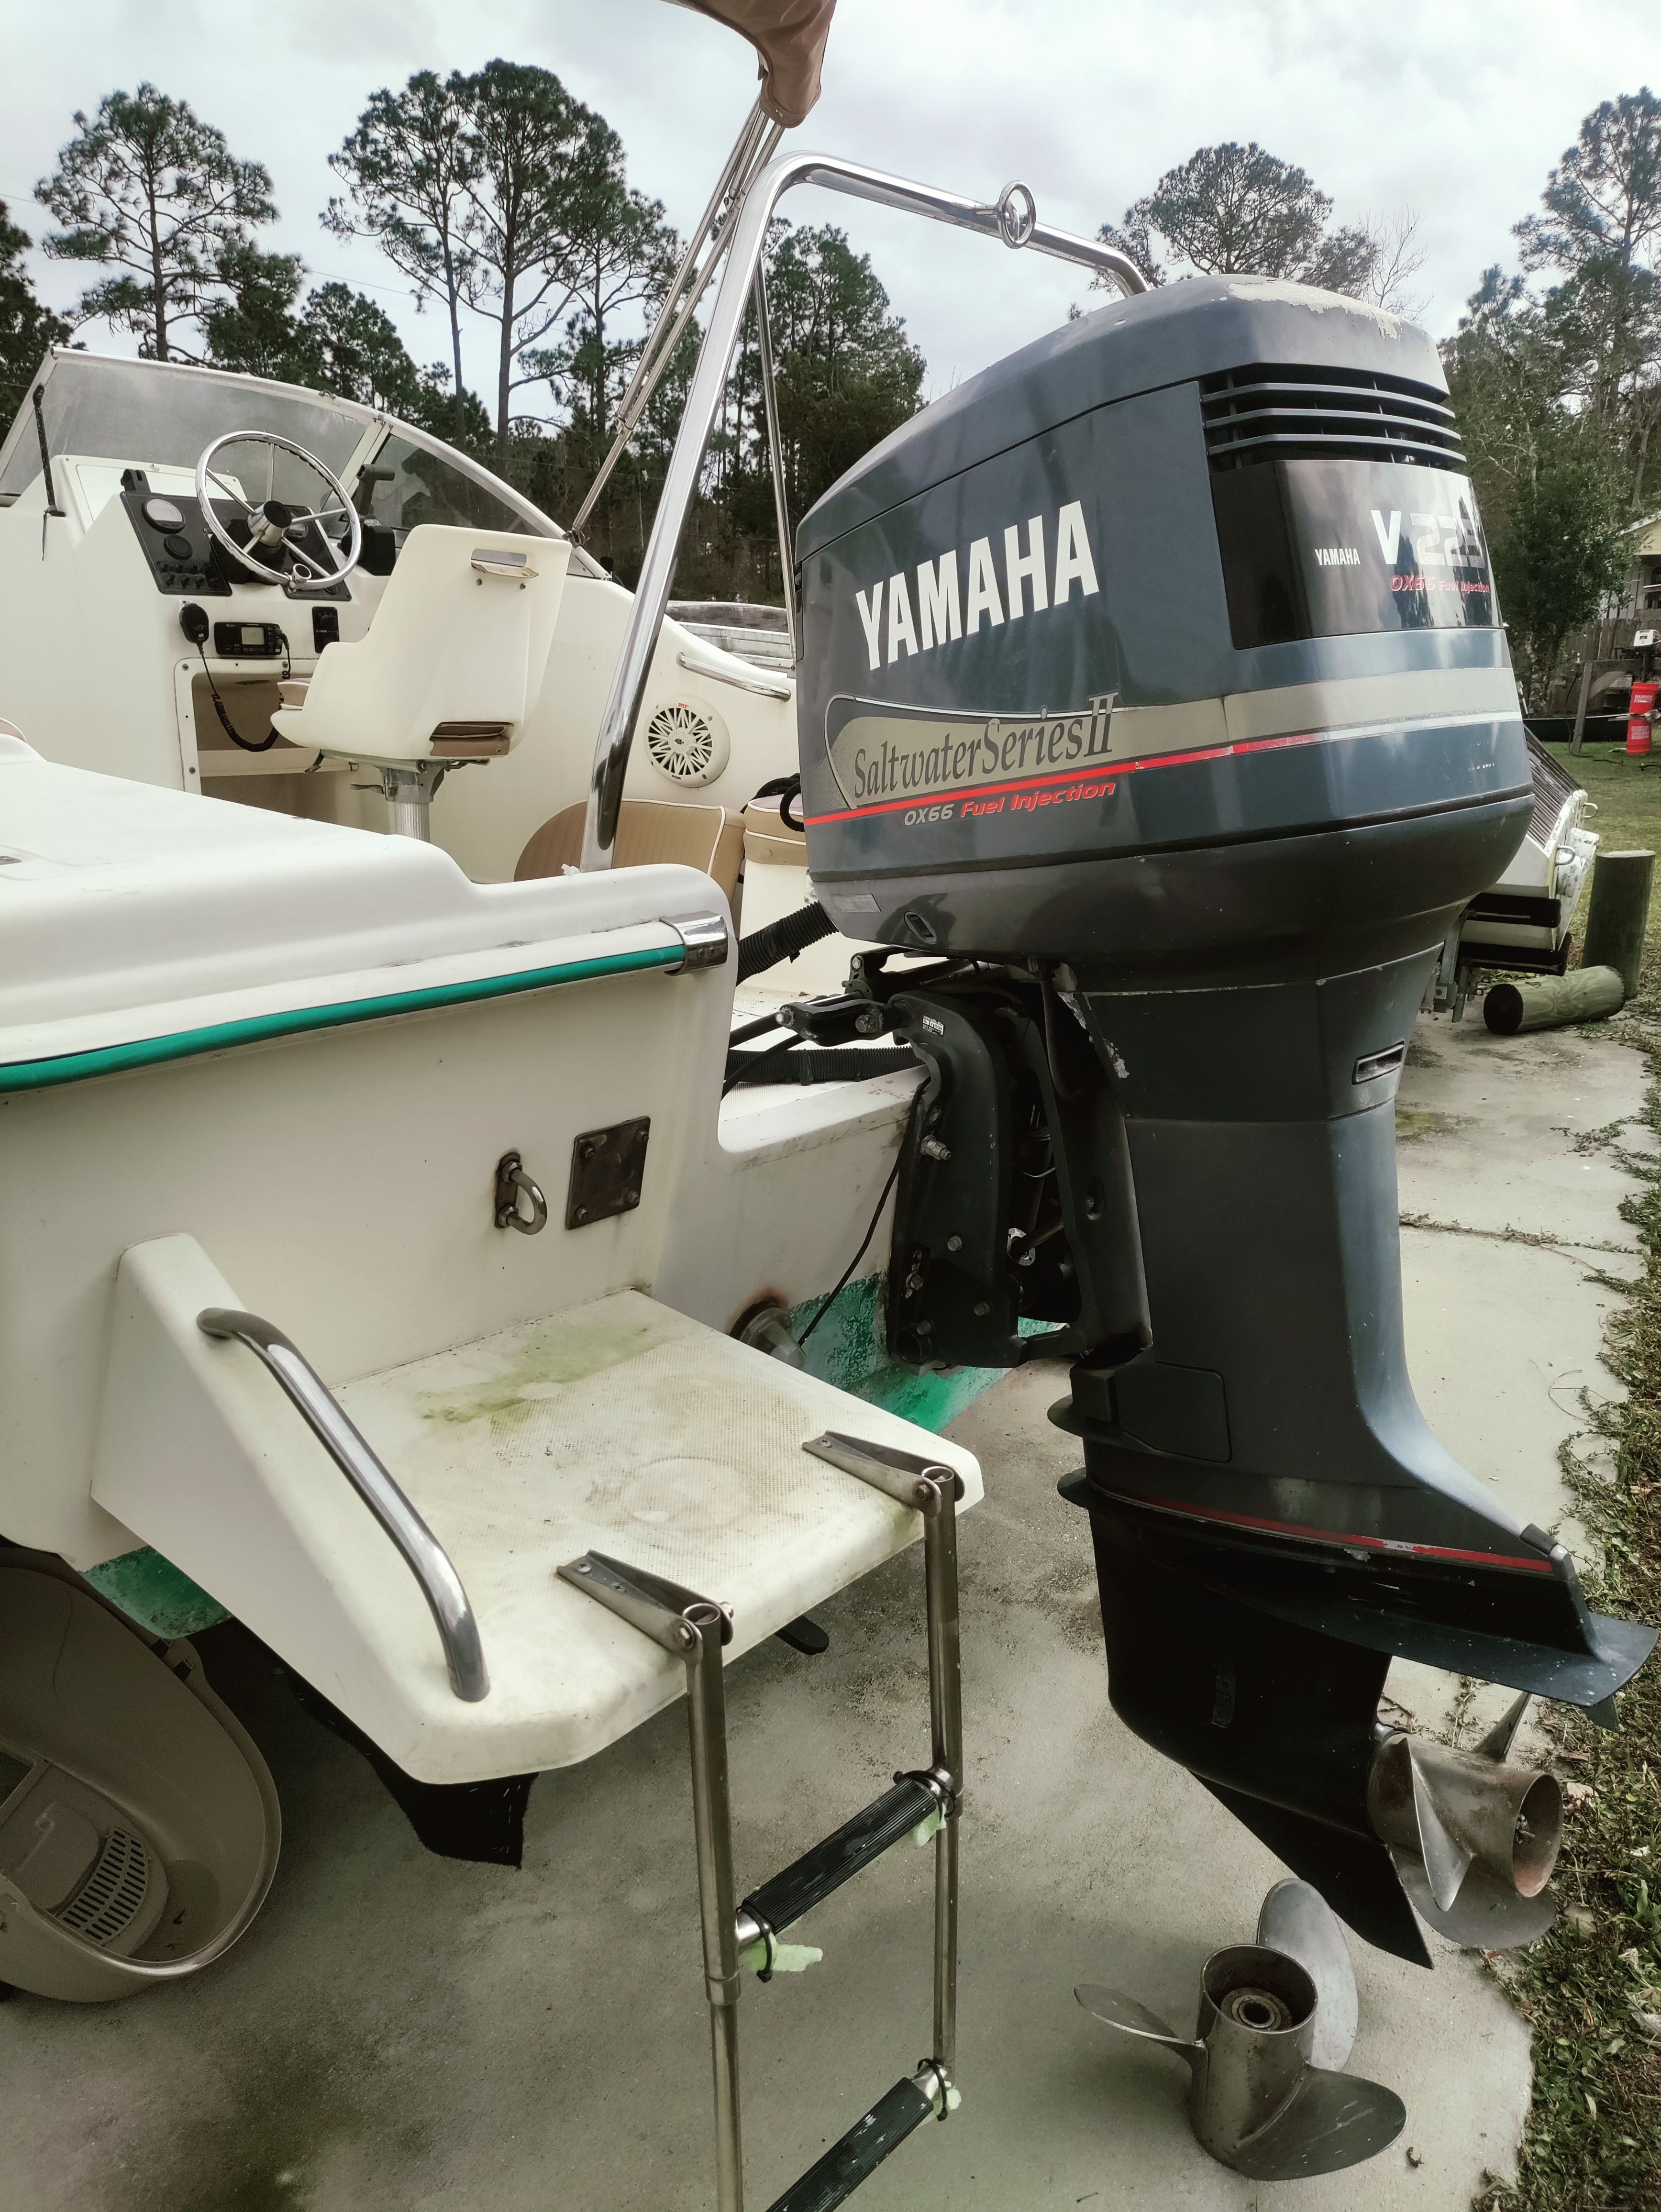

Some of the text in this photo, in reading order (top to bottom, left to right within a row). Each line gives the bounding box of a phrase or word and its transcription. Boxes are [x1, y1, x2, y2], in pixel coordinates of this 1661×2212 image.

[1314, 548, 1361, 565] YAMAHA
[1370, 509, 1402, 564] V
[855, 500, 1099, 670] YAMAHA
[1390, 575, 1490, 594] OX66 Fuel Injection
[904, 782, 1116, 826] OX66 Fuel Injection
